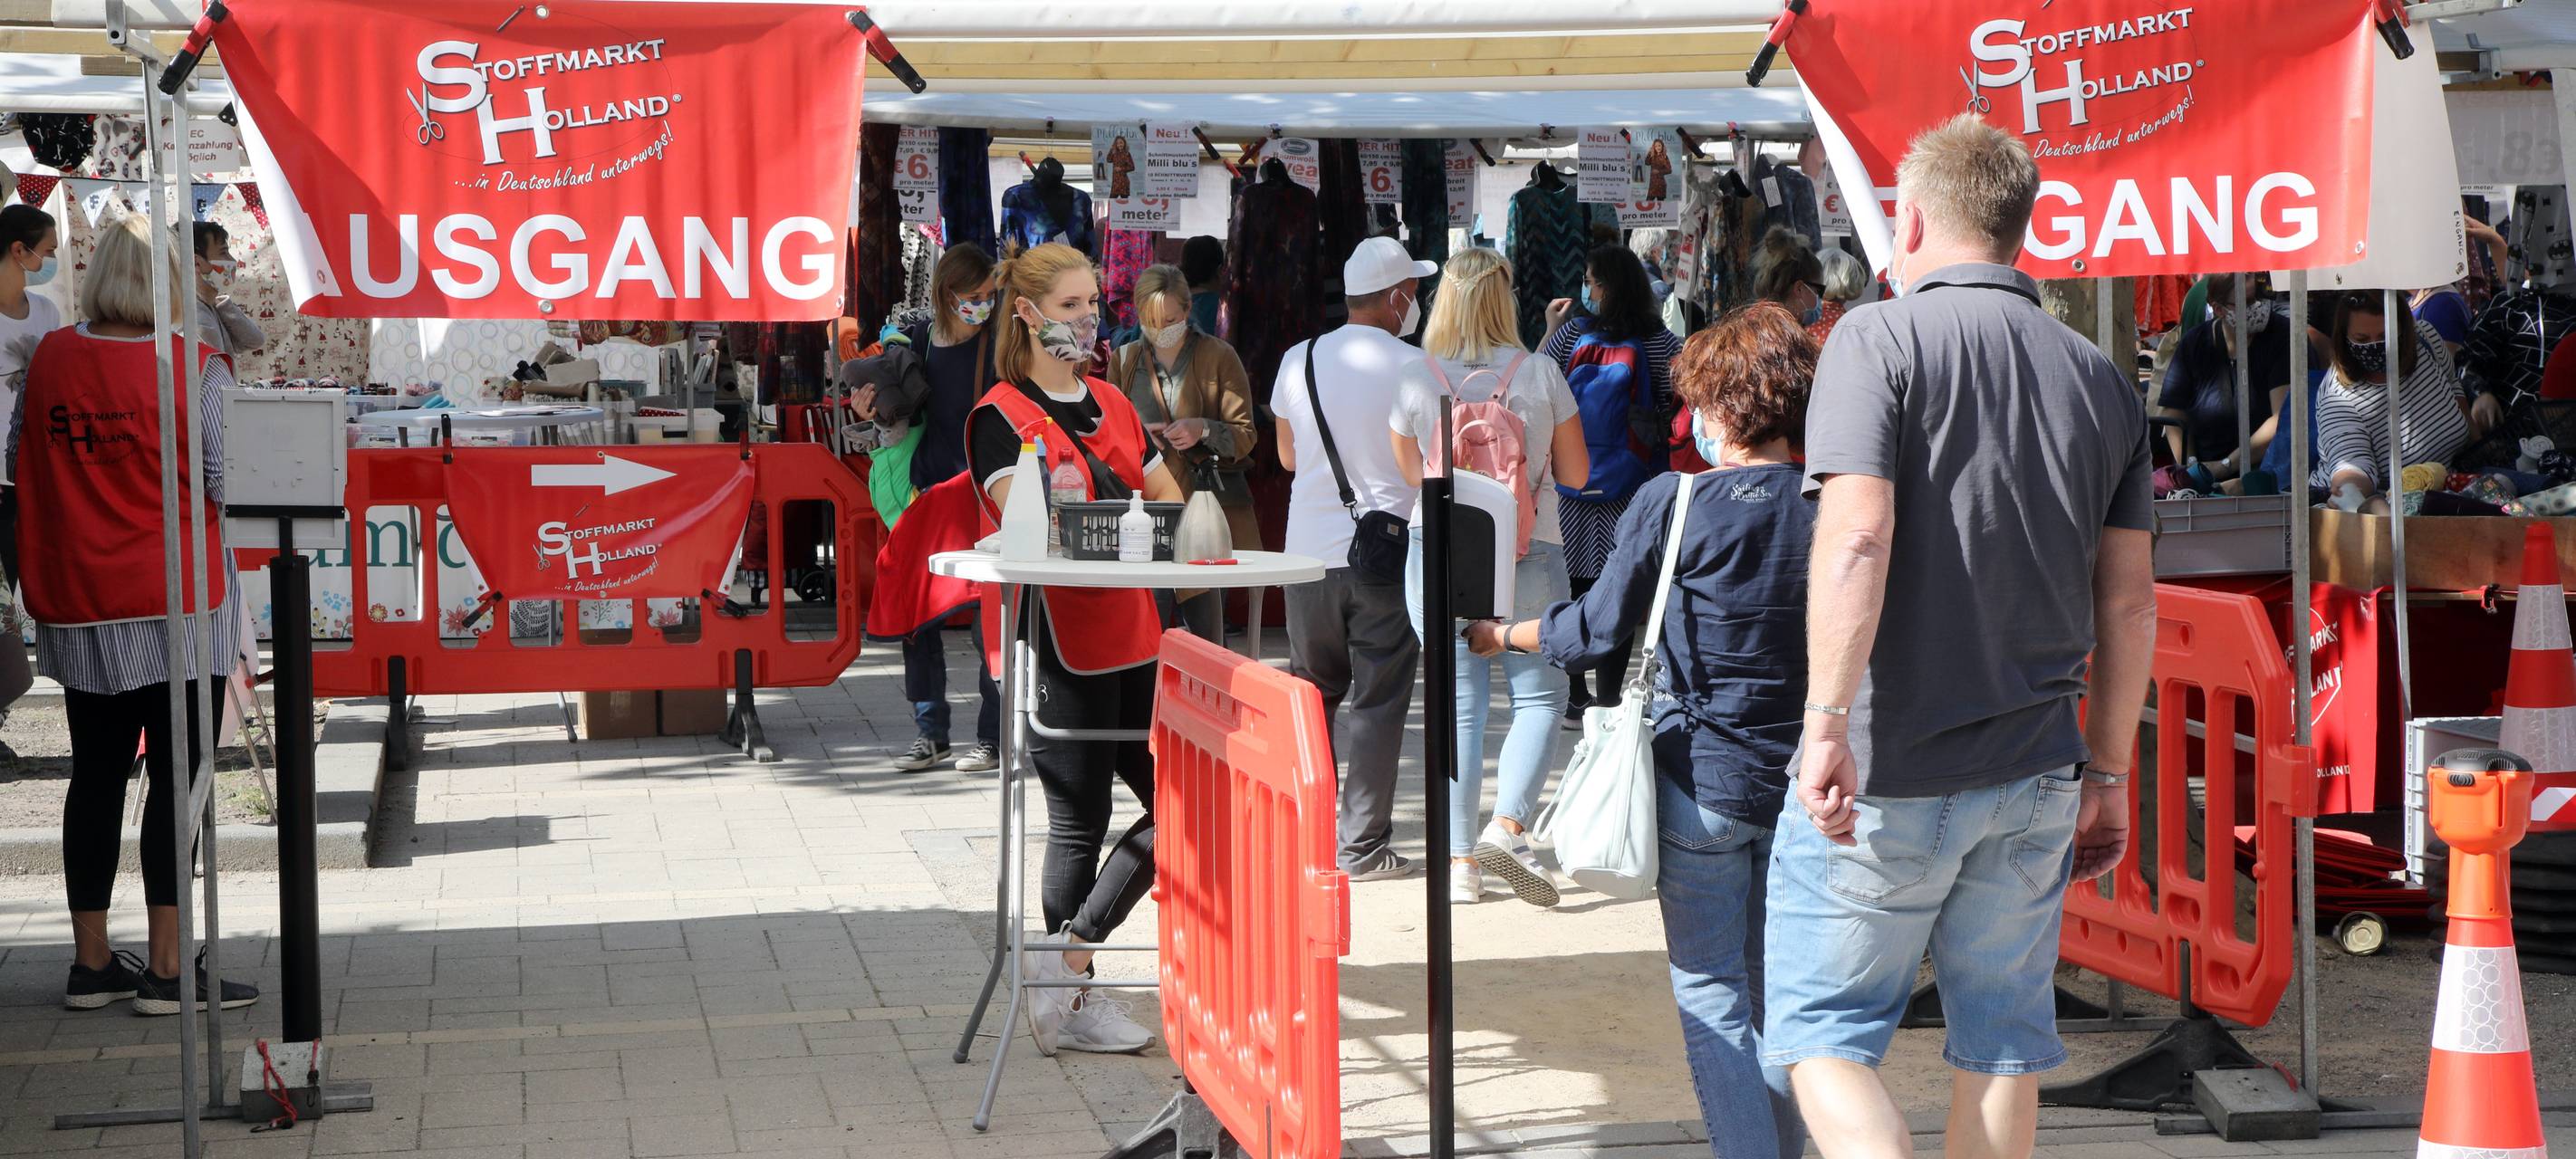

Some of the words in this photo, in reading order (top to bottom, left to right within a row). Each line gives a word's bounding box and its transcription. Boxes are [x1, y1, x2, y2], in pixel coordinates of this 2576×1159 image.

[1970, 7, 2193, 88] STOFFMARKT
[417, 38, 665, 114] STOFFMARKT
[2033, 128, 2122, 159] Deutschland
[2126, 84, 2196, 144] unterwegs!
[189, 129, 205, 139] EC
[1156, 129, 1180, 139] Neu
[1587, 133, 1610, 143] Neu
[163, 140, 233, 151] Kanzahlung
[188, 152, 217, 163] öglich
[497, 163, 595, 193] Deutschland
[601, 120, 675, 179] unterwegs!
[1148, 159, 1169, 168] Milli
[1445, 155, 1475, 170] eat
[1122, 209, 1168, 220] meter
[1622, 213, 1638, 221] pro
[1640, 211, 1668, 219] meter
[1831, 217, 1847, 225] pro
[538, 517, 656, 555] STOFFMARKT
[574, 577, 621, 592] Deutschland
